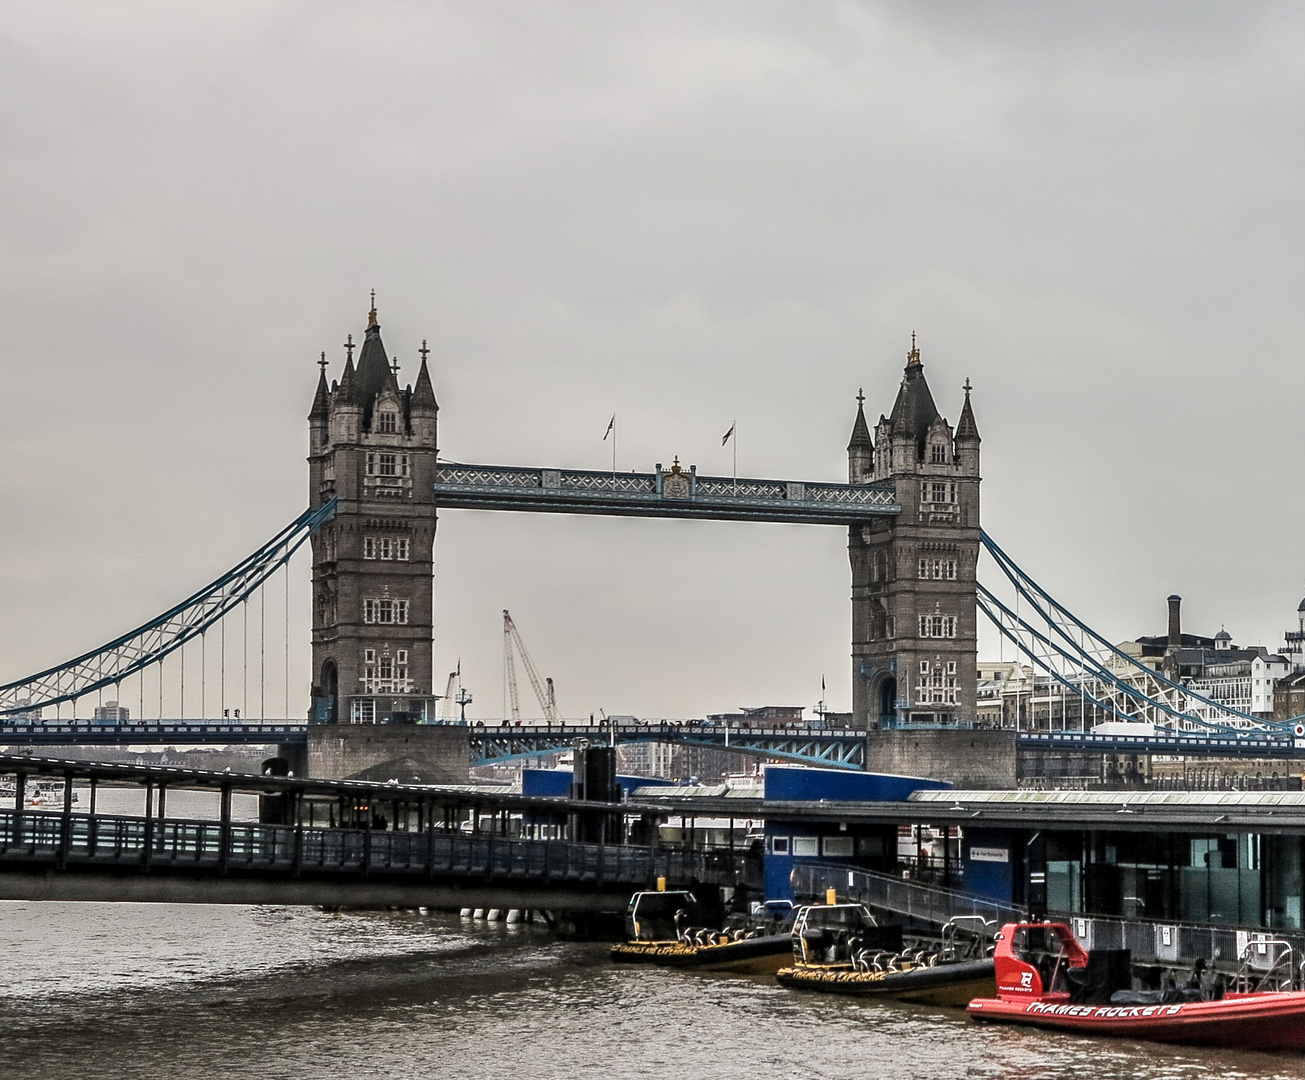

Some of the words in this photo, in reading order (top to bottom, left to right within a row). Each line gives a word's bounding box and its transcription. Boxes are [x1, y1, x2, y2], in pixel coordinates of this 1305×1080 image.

[657, 946, 698, 955] EXPERIENCE
[792, 968, 821, 980] THAMES
[822, 971, 837, 981] RIB
[837, 971, 887, 982] EXPERIENCE
[1026, 1001, 1097, 1017] THAMES
[1094, 1003, 1187, 1017] ROCKETS
